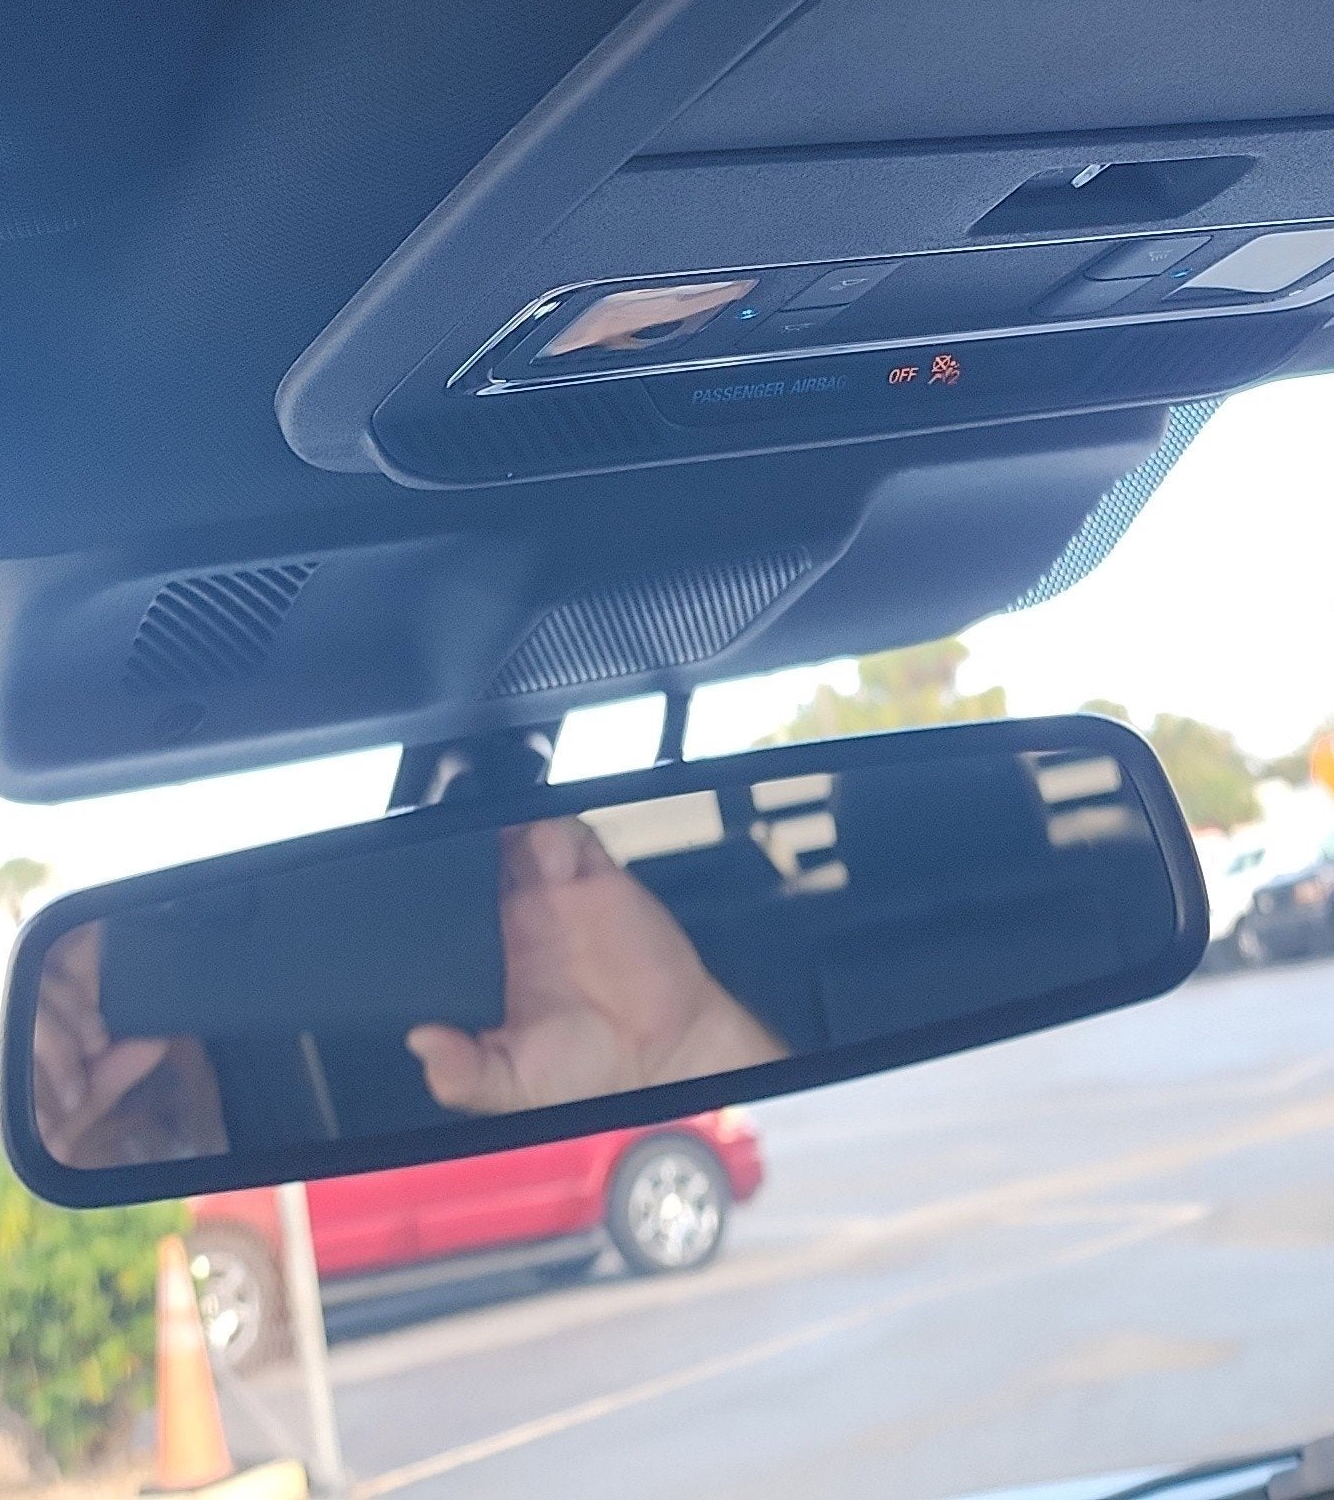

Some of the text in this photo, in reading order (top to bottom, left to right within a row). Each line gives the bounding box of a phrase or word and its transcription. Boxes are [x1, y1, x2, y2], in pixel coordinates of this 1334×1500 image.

[692, 366, 919, 404] PASSENGER AIRBAG OFF
